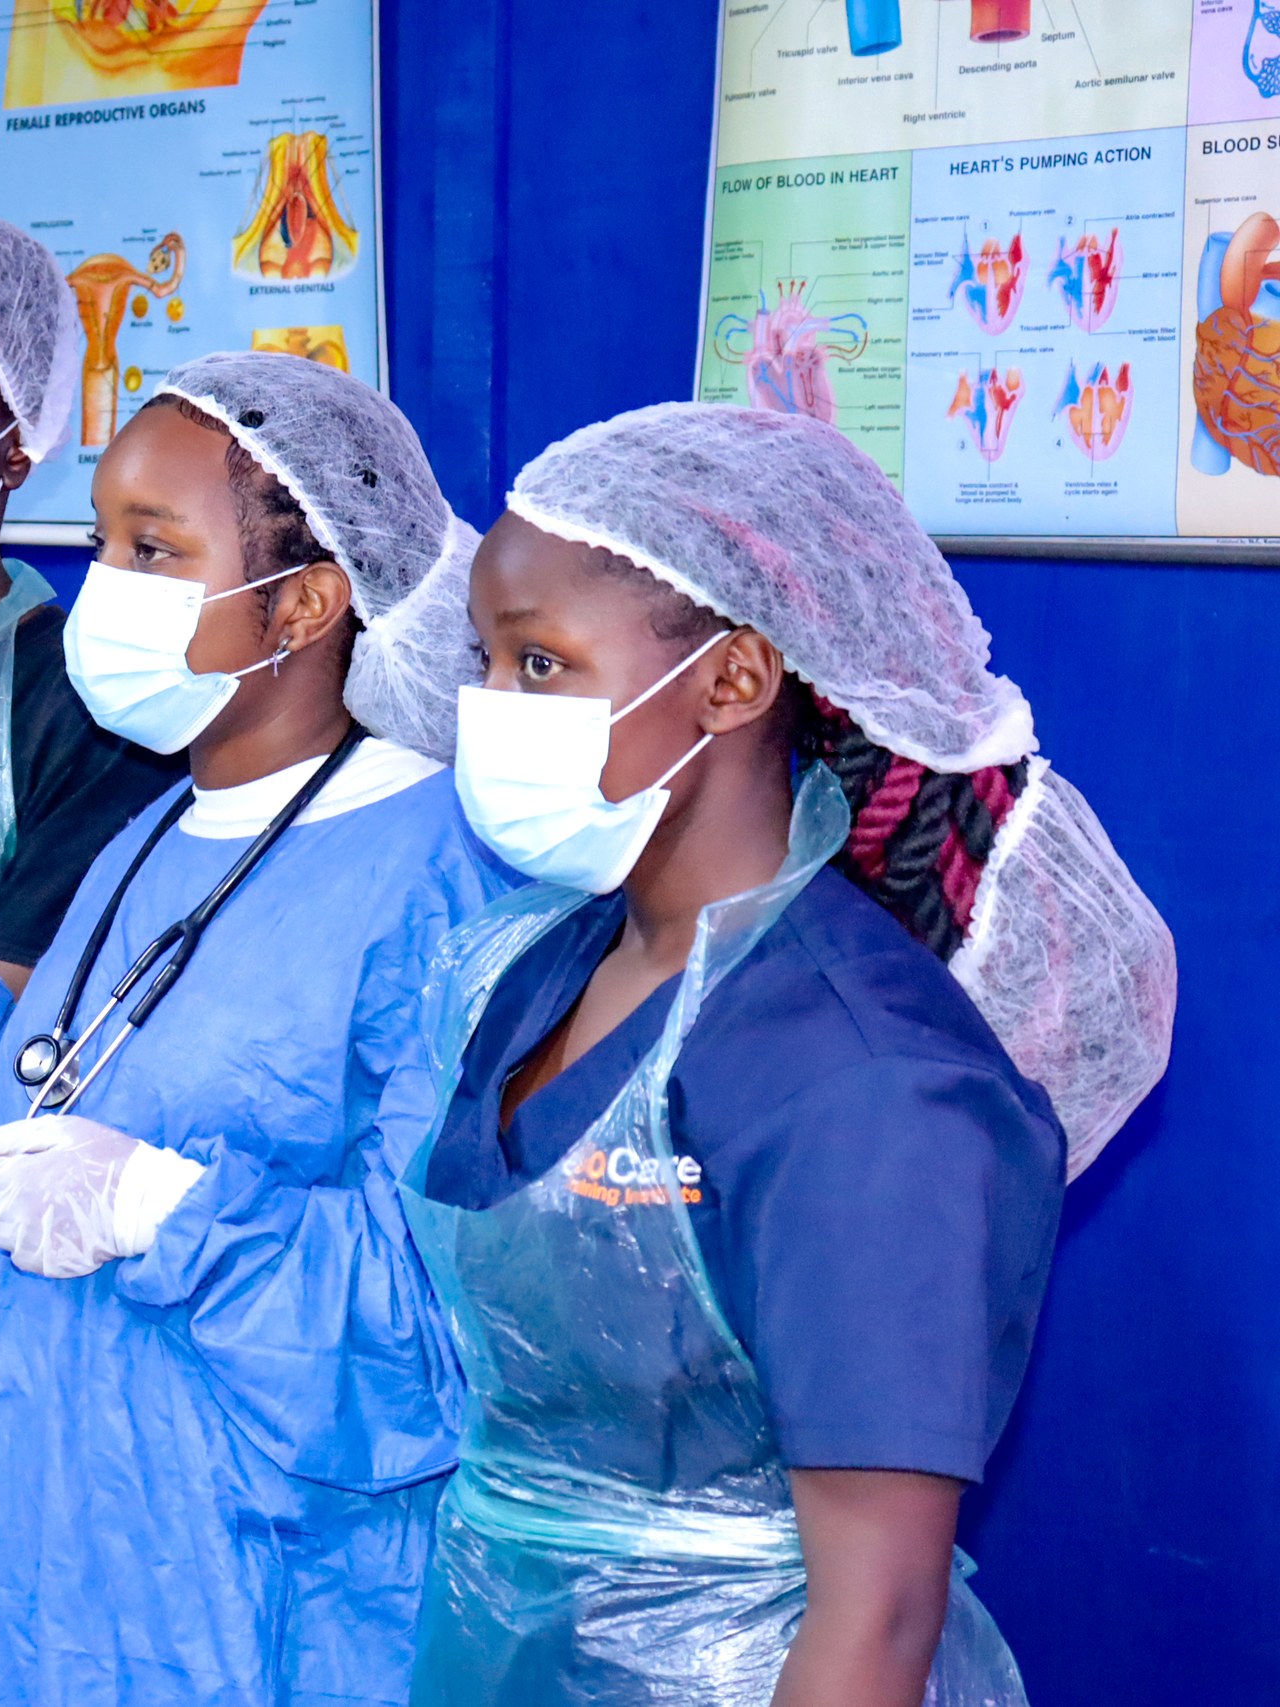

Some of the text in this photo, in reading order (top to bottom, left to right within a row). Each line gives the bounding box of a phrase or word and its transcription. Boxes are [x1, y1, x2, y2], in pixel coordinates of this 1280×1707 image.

[1041, 30, 1076, 43] Septum
[777, 44, 839, 59] Tricuspid valve
[959, 60, 1038, 76] Descending aorta
[838, 72, 914, 86] Inferior vena cava
[1075, 71, 1176, 89] Aortic semilunar valve
[6, 99, 206, 132] FEMALE REPRODUCTIVE ORGANS
[903, 109, 967, 125] Right ventricle
[1202, 135, 1280, 155] BLOOD S
[949, 145, 1152, 176] HEART'S PUMPING ACTION
[722, 166, 900, 195] FLOW OF BLOOD IN HEART
[249, 283, 335, 296] EXTERNAL GENITALS
